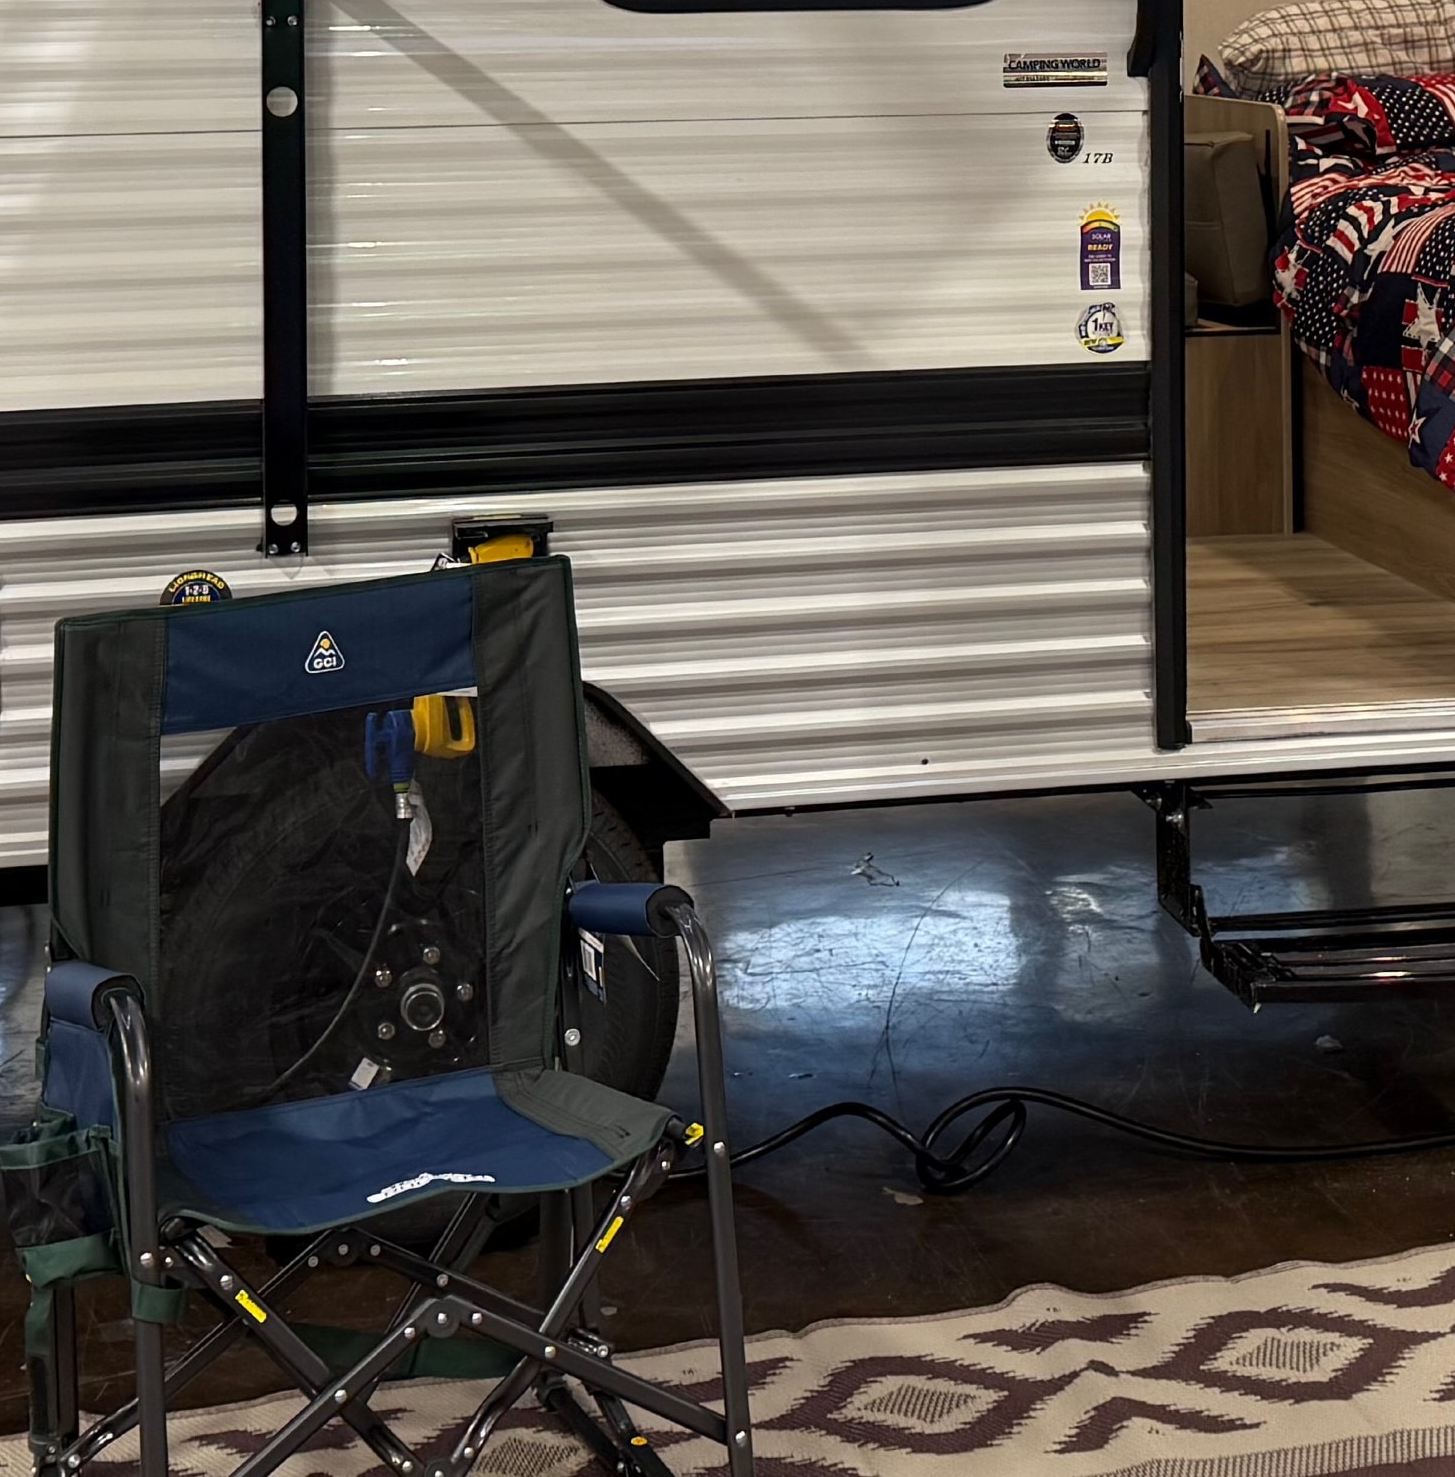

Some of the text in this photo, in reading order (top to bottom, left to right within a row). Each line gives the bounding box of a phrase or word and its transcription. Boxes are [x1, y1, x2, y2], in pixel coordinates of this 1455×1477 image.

[1008, 58, 1101, 70] CAMPING WORLD
[1087, 243, 1113, 251] READY
[313, 656, 337, 669] GCI
